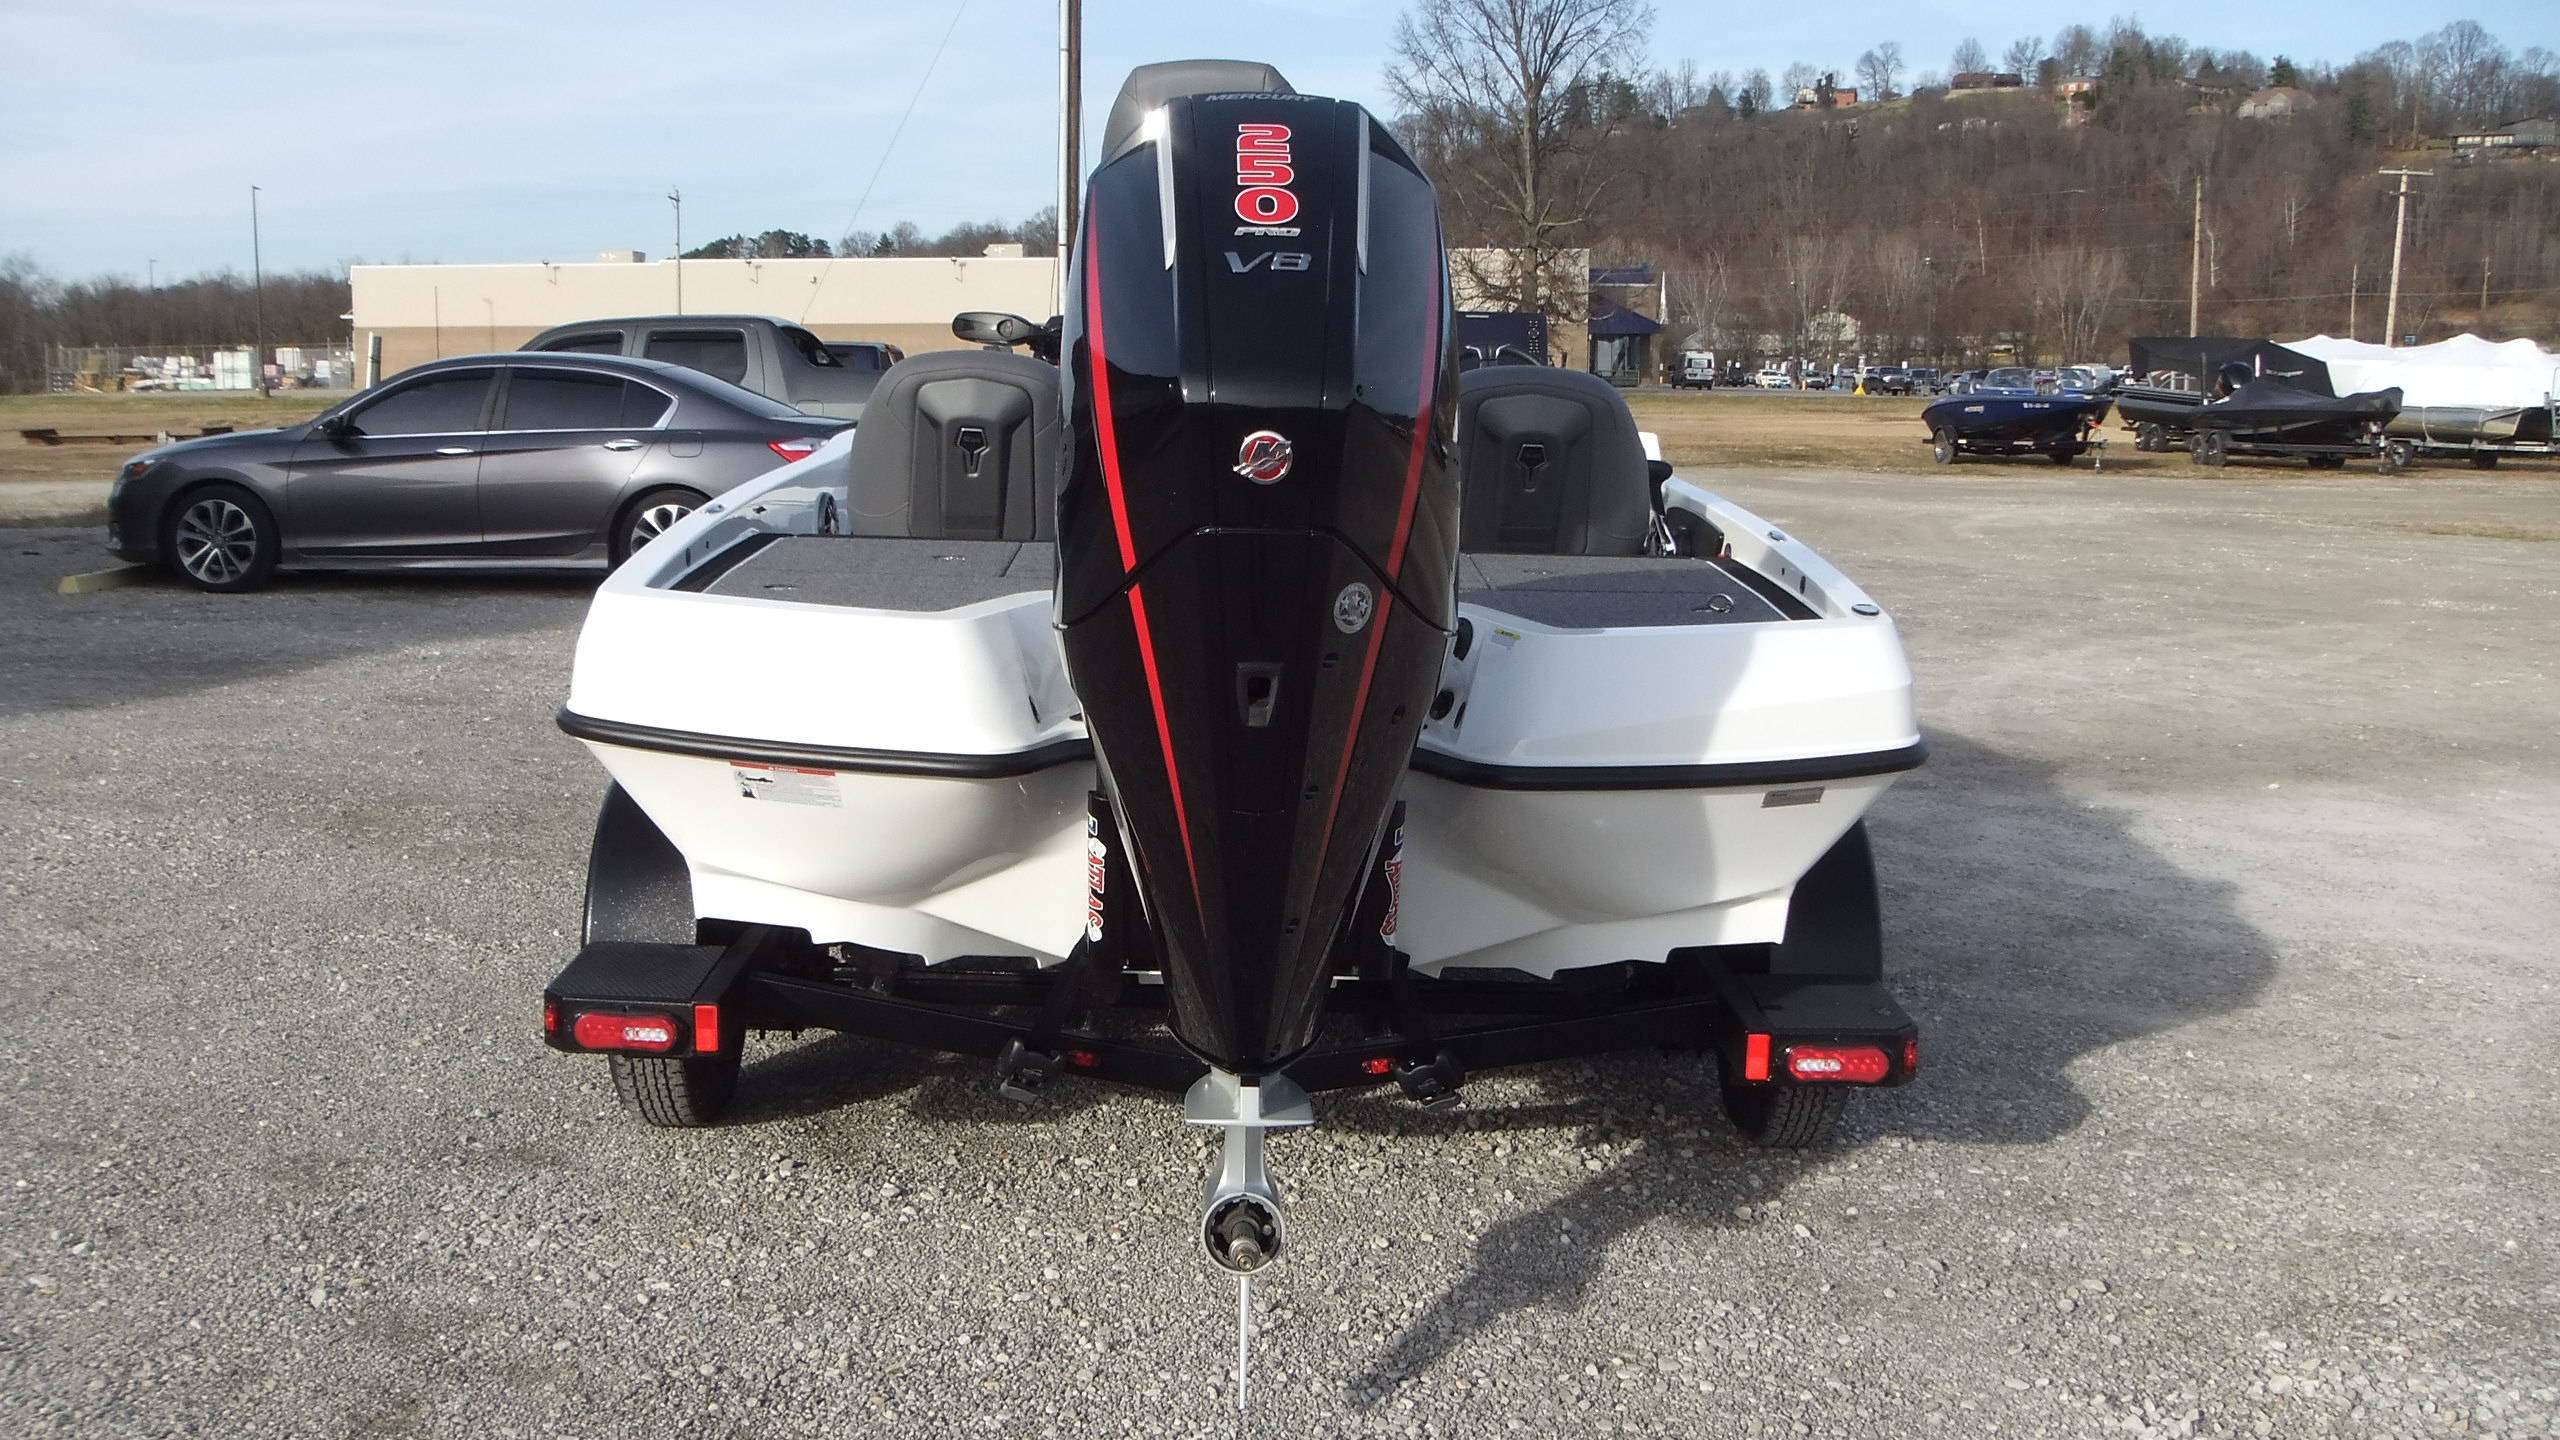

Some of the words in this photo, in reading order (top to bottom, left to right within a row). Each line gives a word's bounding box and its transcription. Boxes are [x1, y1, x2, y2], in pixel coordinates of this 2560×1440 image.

[1205, 93, 1317, 102] MERCURY
[1234, 123, 1299, 225] 250
[1234, 226, 1301, 237] PRO
[1224, 251, 1312, 273] V8
